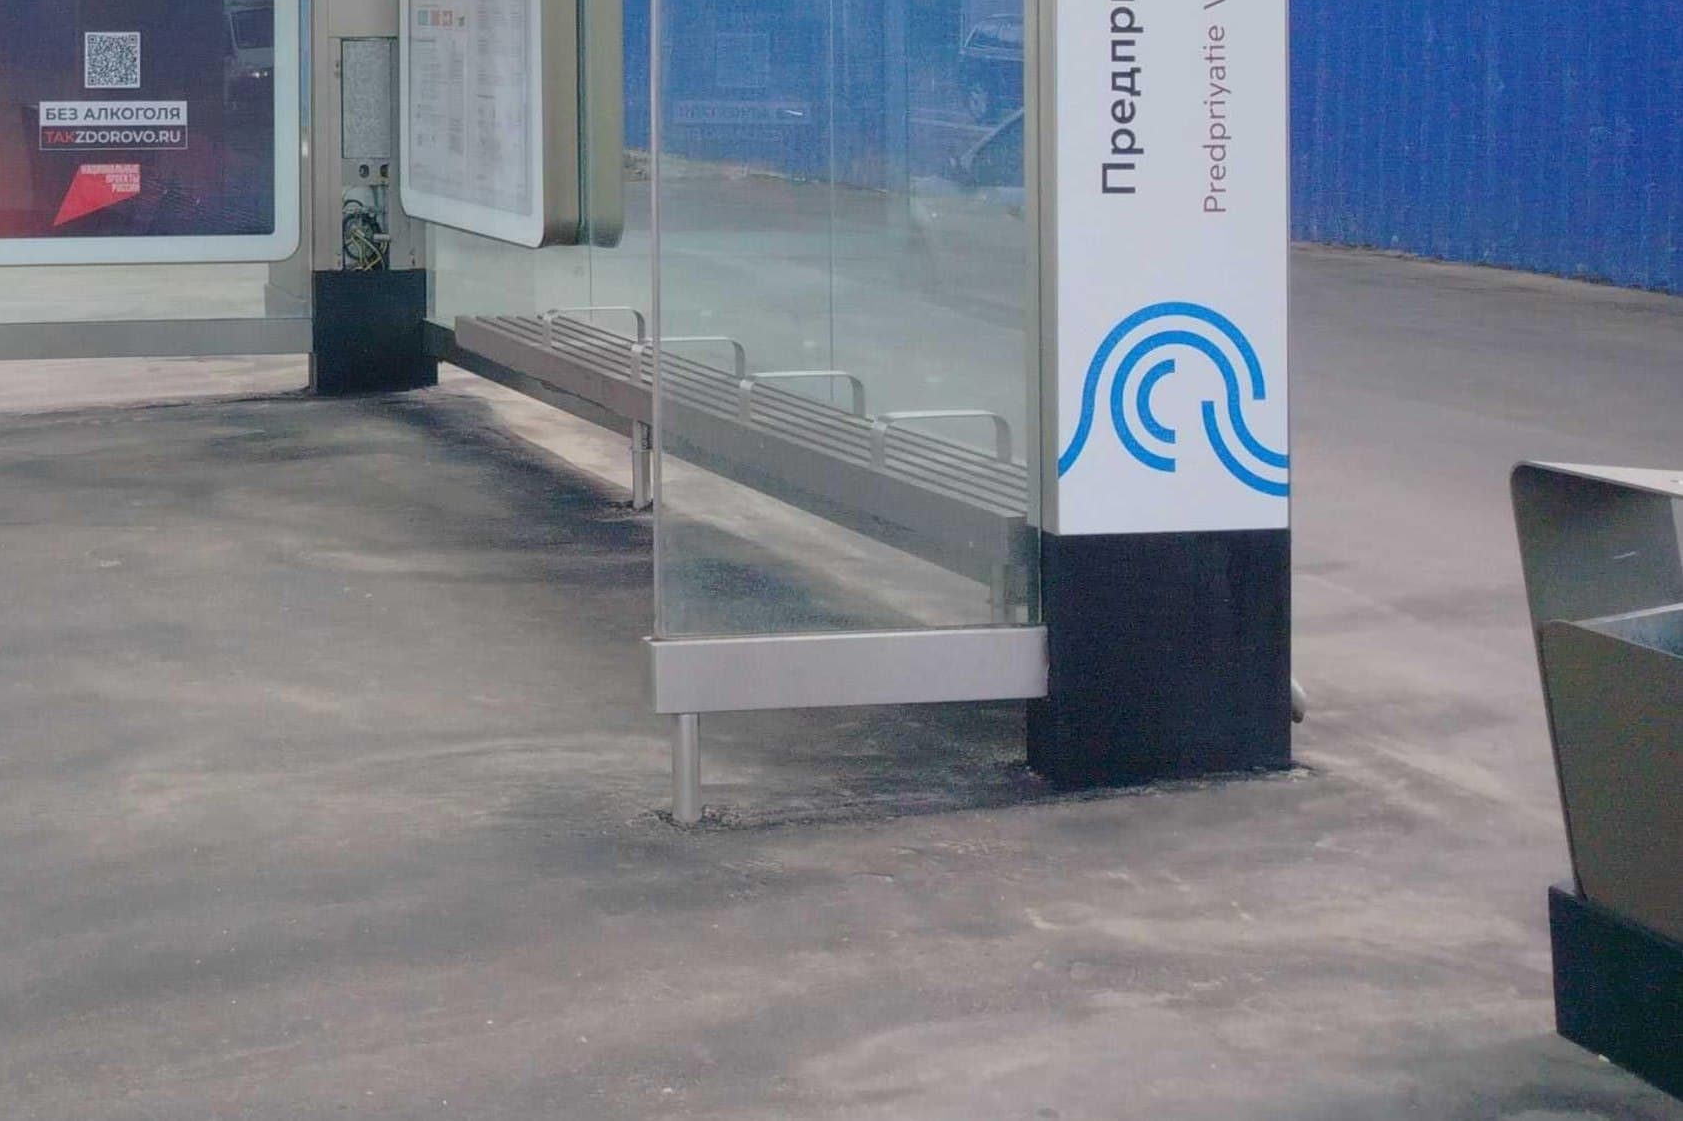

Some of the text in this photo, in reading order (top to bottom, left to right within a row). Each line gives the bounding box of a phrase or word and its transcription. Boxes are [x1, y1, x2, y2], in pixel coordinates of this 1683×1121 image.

[45, 107, 181, 121] БЕЗ АЛКОГОЛЯ
[1202, 24, 1231, 214] Predpriyatie
[46, 130, 181, 144] TAKZDOROVO.RU
